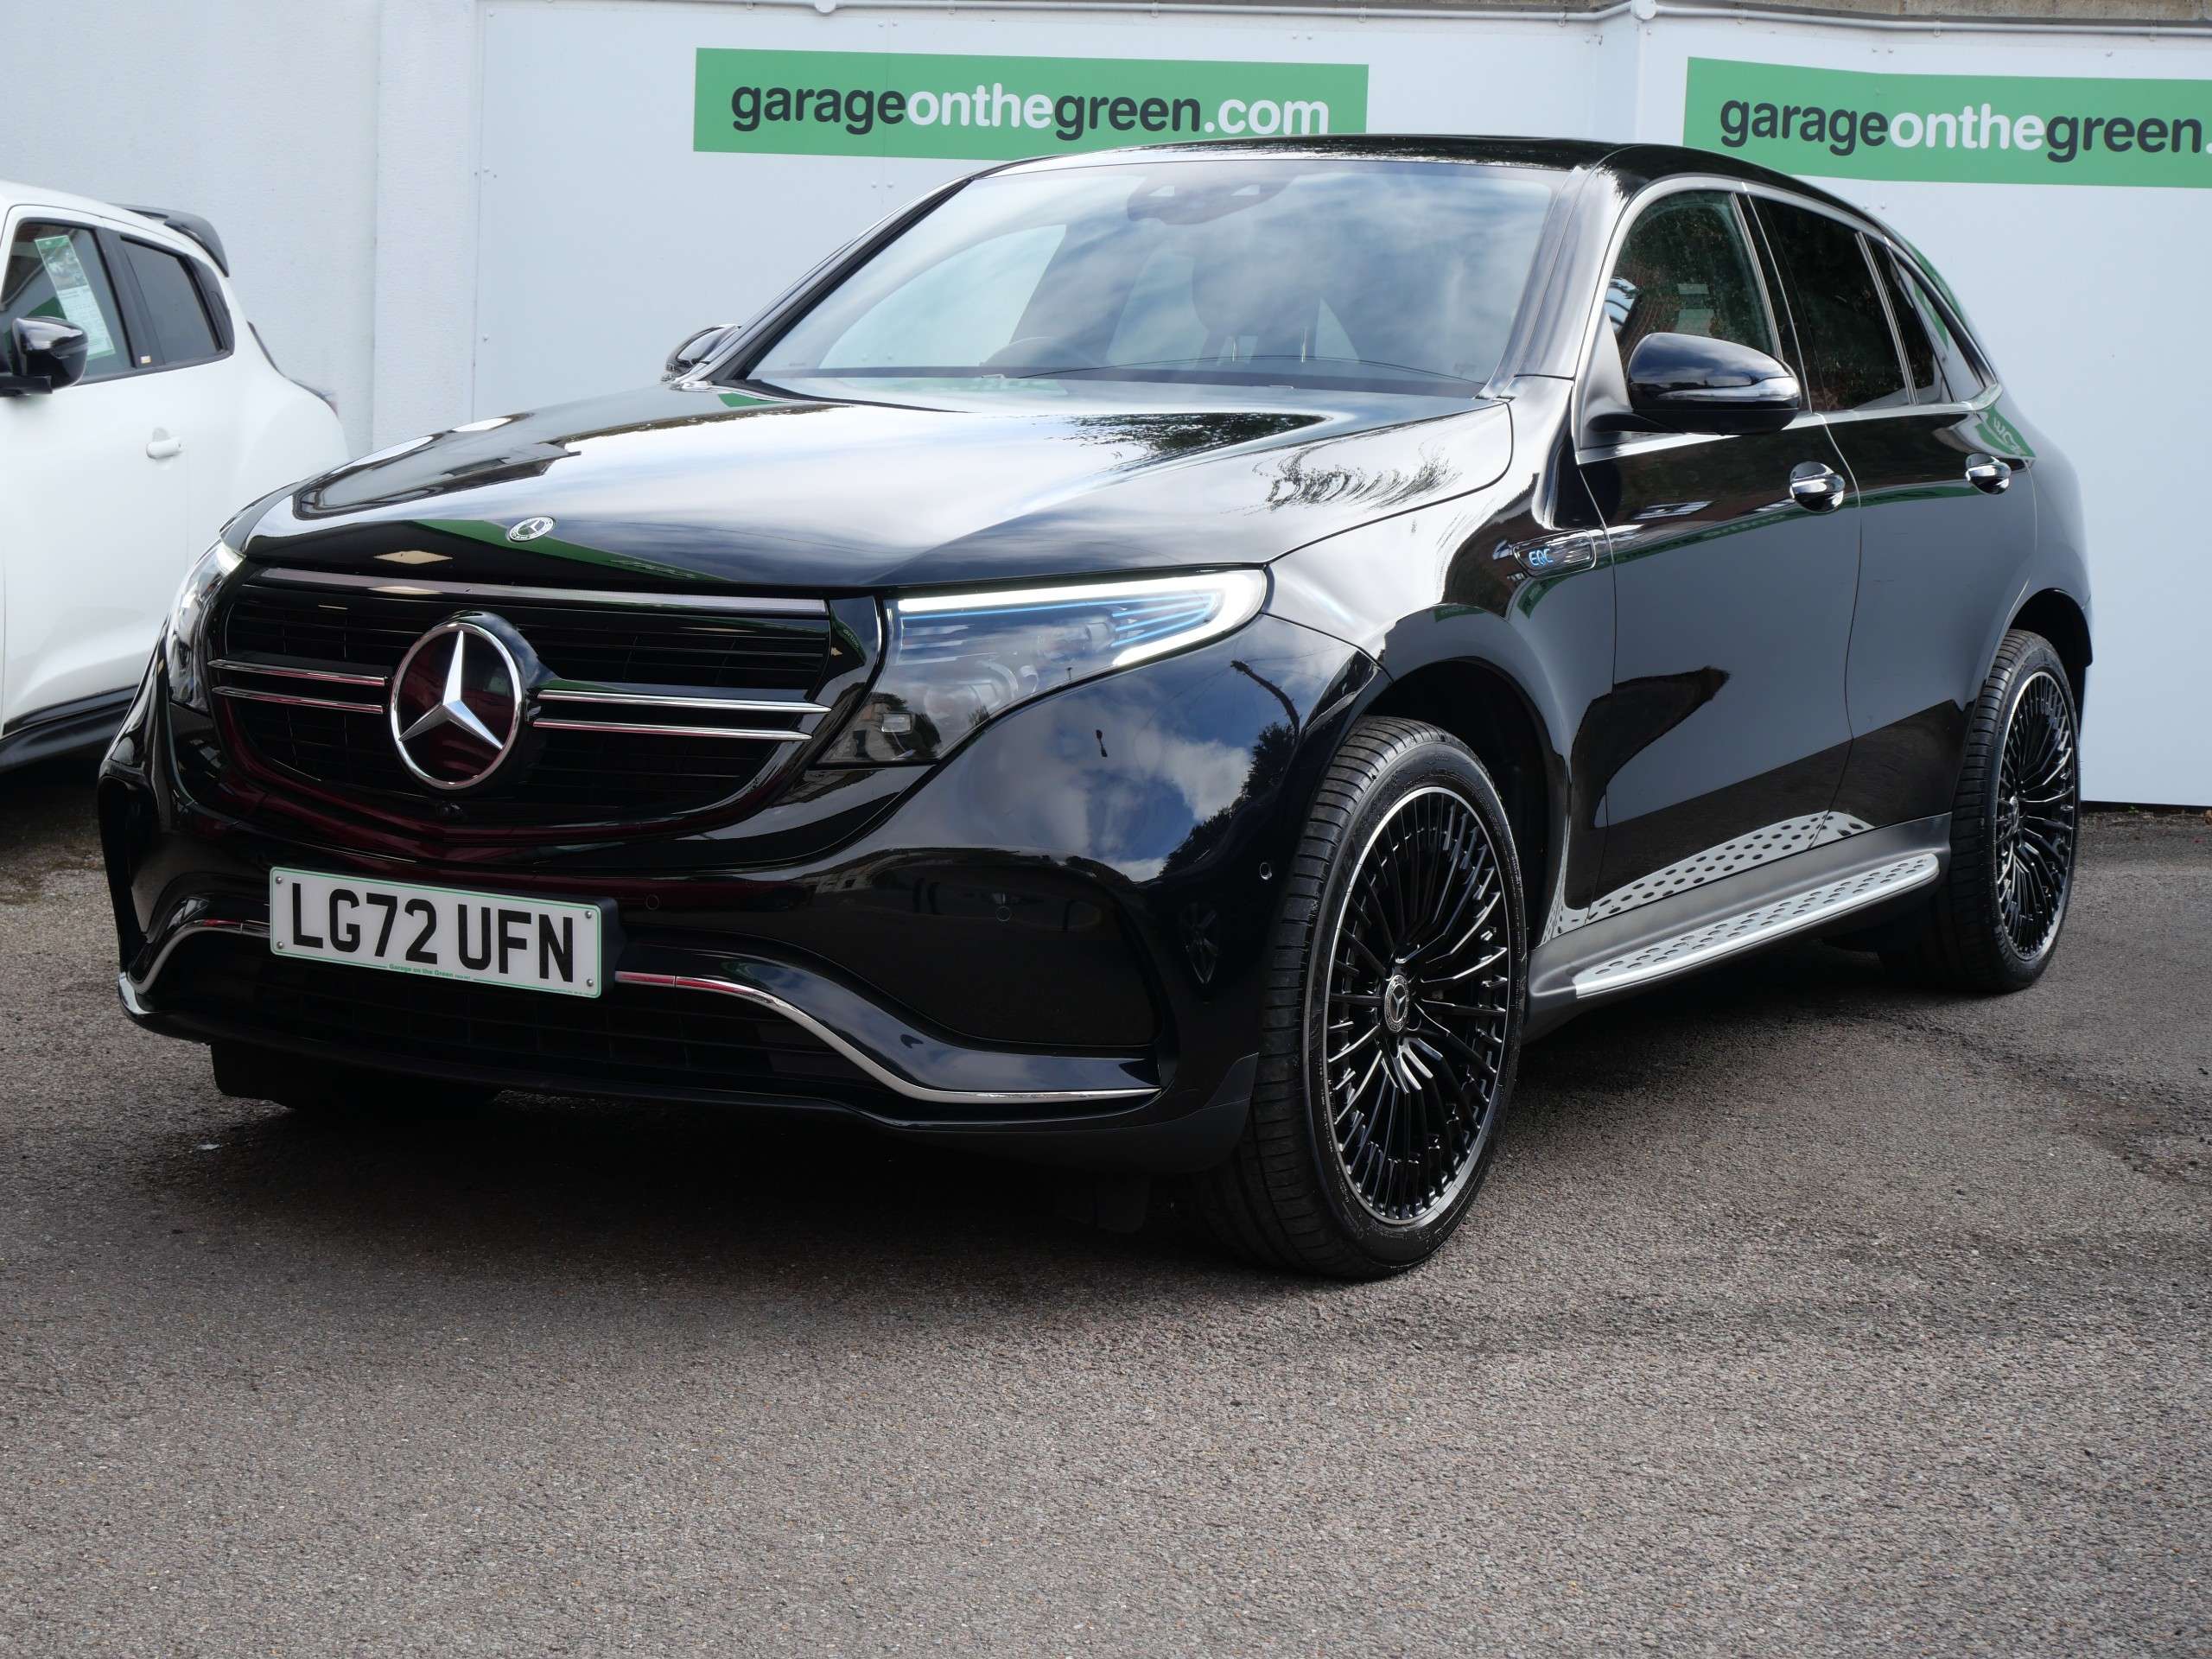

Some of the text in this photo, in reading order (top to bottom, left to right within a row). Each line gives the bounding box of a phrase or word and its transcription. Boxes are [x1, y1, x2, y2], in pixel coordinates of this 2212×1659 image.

[731, 82, 1329, 141] garageonthegreen.com
[1529, 548, 1554, 566] EQC
[291, 882, 574, 983] LG72 UFN
[389, 963, 412, 973] Garage
[435, 969, 453, 978] Green
